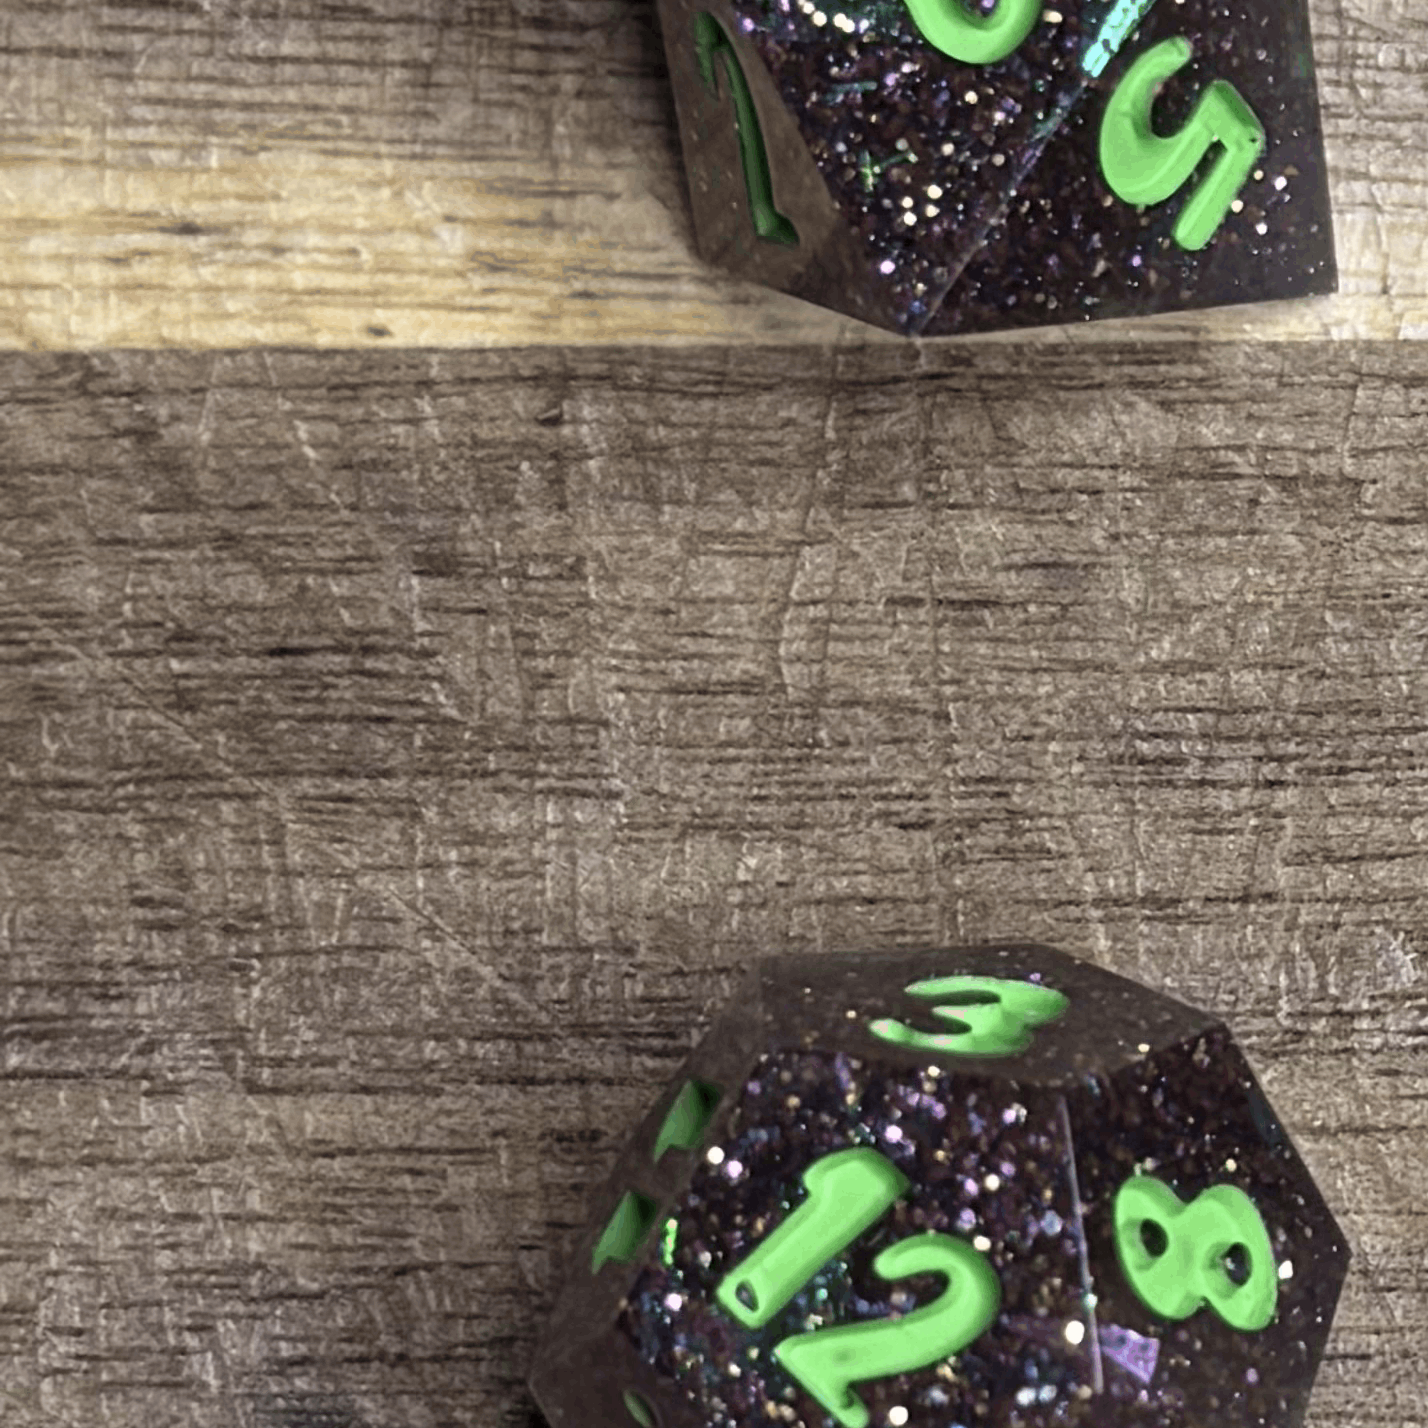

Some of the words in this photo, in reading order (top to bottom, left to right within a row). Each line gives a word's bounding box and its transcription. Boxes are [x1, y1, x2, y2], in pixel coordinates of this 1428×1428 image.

[1100, 35, 1266, 251] 5
[869, 975, 1069, 1058] 3
[1113, 1175, 1278, 1331] 8
